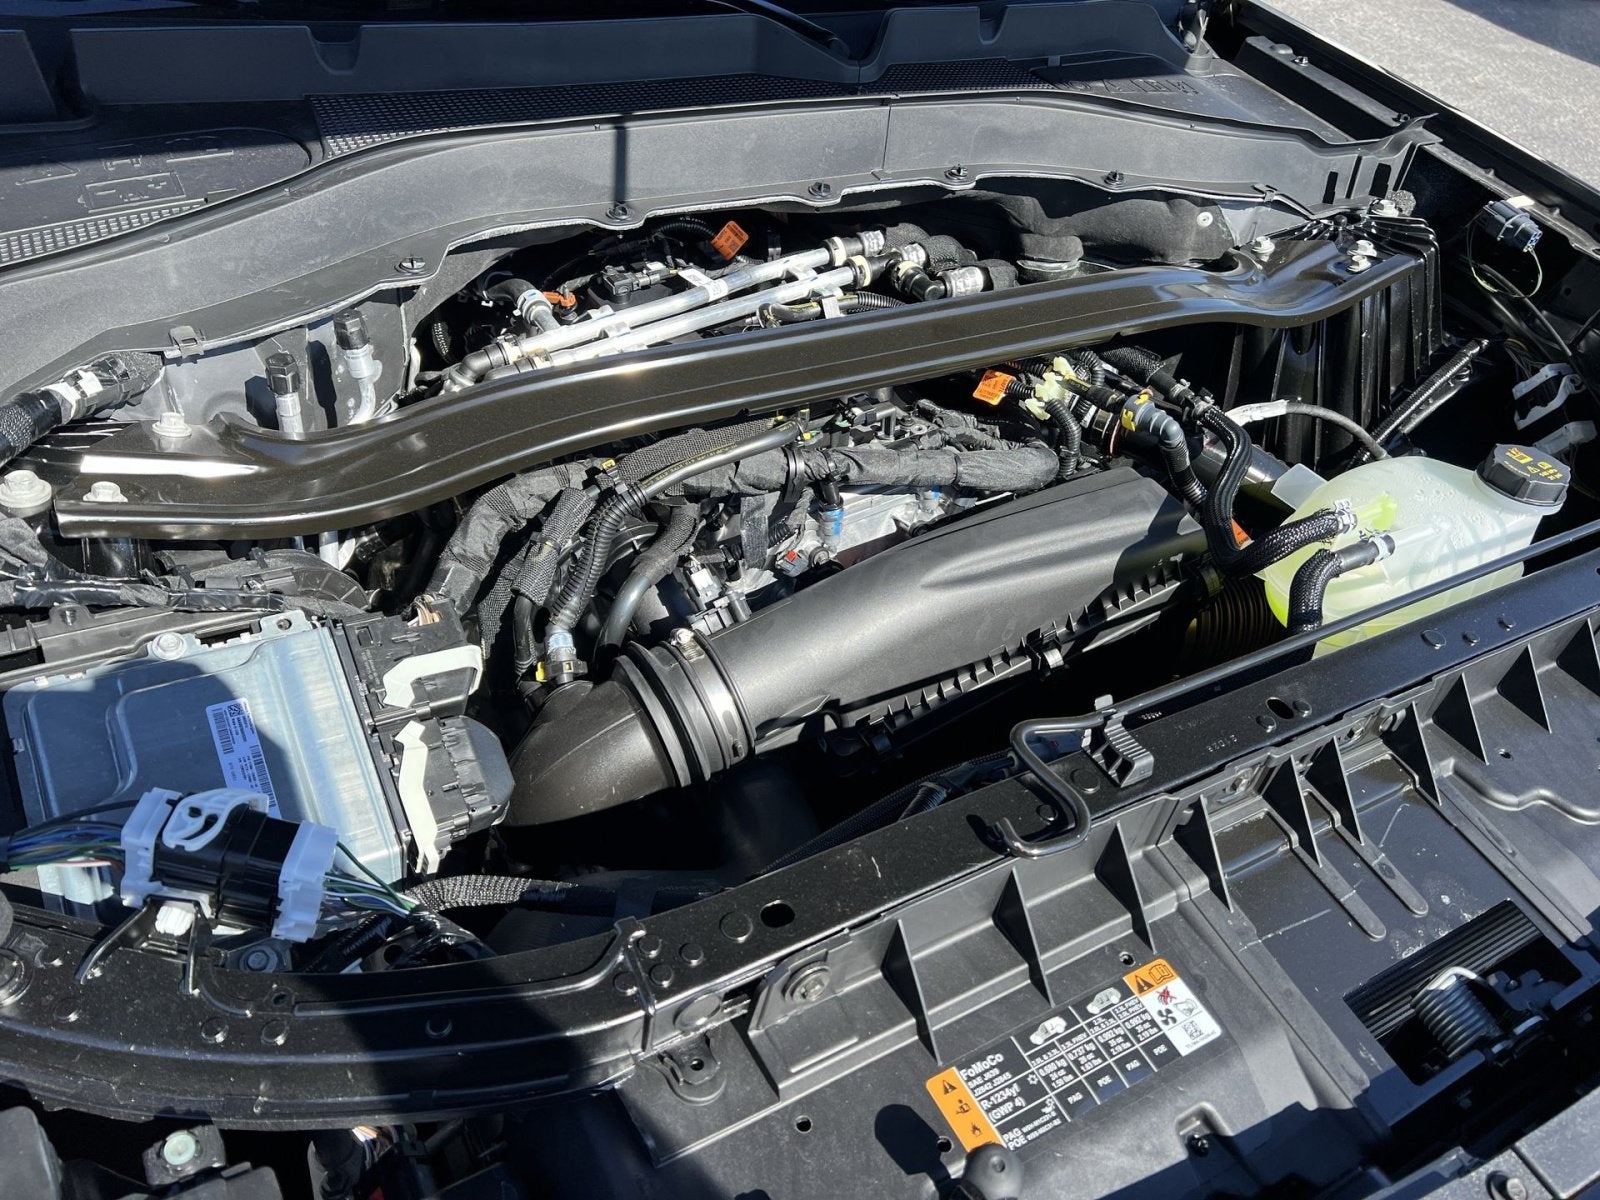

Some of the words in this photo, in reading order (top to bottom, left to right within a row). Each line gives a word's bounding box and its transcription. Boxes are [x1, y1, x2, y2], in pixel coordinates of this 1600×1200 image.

[1140, 1012, 1152, 1021] kg
[1113, 1027, 1125, 1035] kg
[1148, 1027, 1159, 1035] lbs
[1115, 1036, 1124, 1044] oz
[1083, 1042, 1096, 1051] kg
[1121, 1042, 1132, 1050] lbs
[1153, 1044, 1168, 1055] POE
[959, 1053, 1004, 1081] FoMoCo
[1055, 1058, 1068, 1067] kg
[1091, 1058, 1103, 1066] lbs
[1126, 1060, 1141, 1071] PAG
[967, 1076, 984, 1089] SAE
[983, 1068, 1000, 1081] J639
[1057, 1069, 1066, 1077] oz
[1062, 1074, 1074, 1083] lbs
[974, 1082, 993, 1097] J2842
[992, 1072, 1012, 1086] J2845
[1097, 1075, 1112, 1087] POE
[980, 1083, 1020, 1110] R-1234yf
[1067, 1092, 1083, 1104] PAG
[988, 1101, 1014, 1123] (GWP
[1014, 1096, 1026, 1107] 4)
[1002, 1128, 1022, 1143] PAG
[1007, 1135, 1028, 1151] POE
